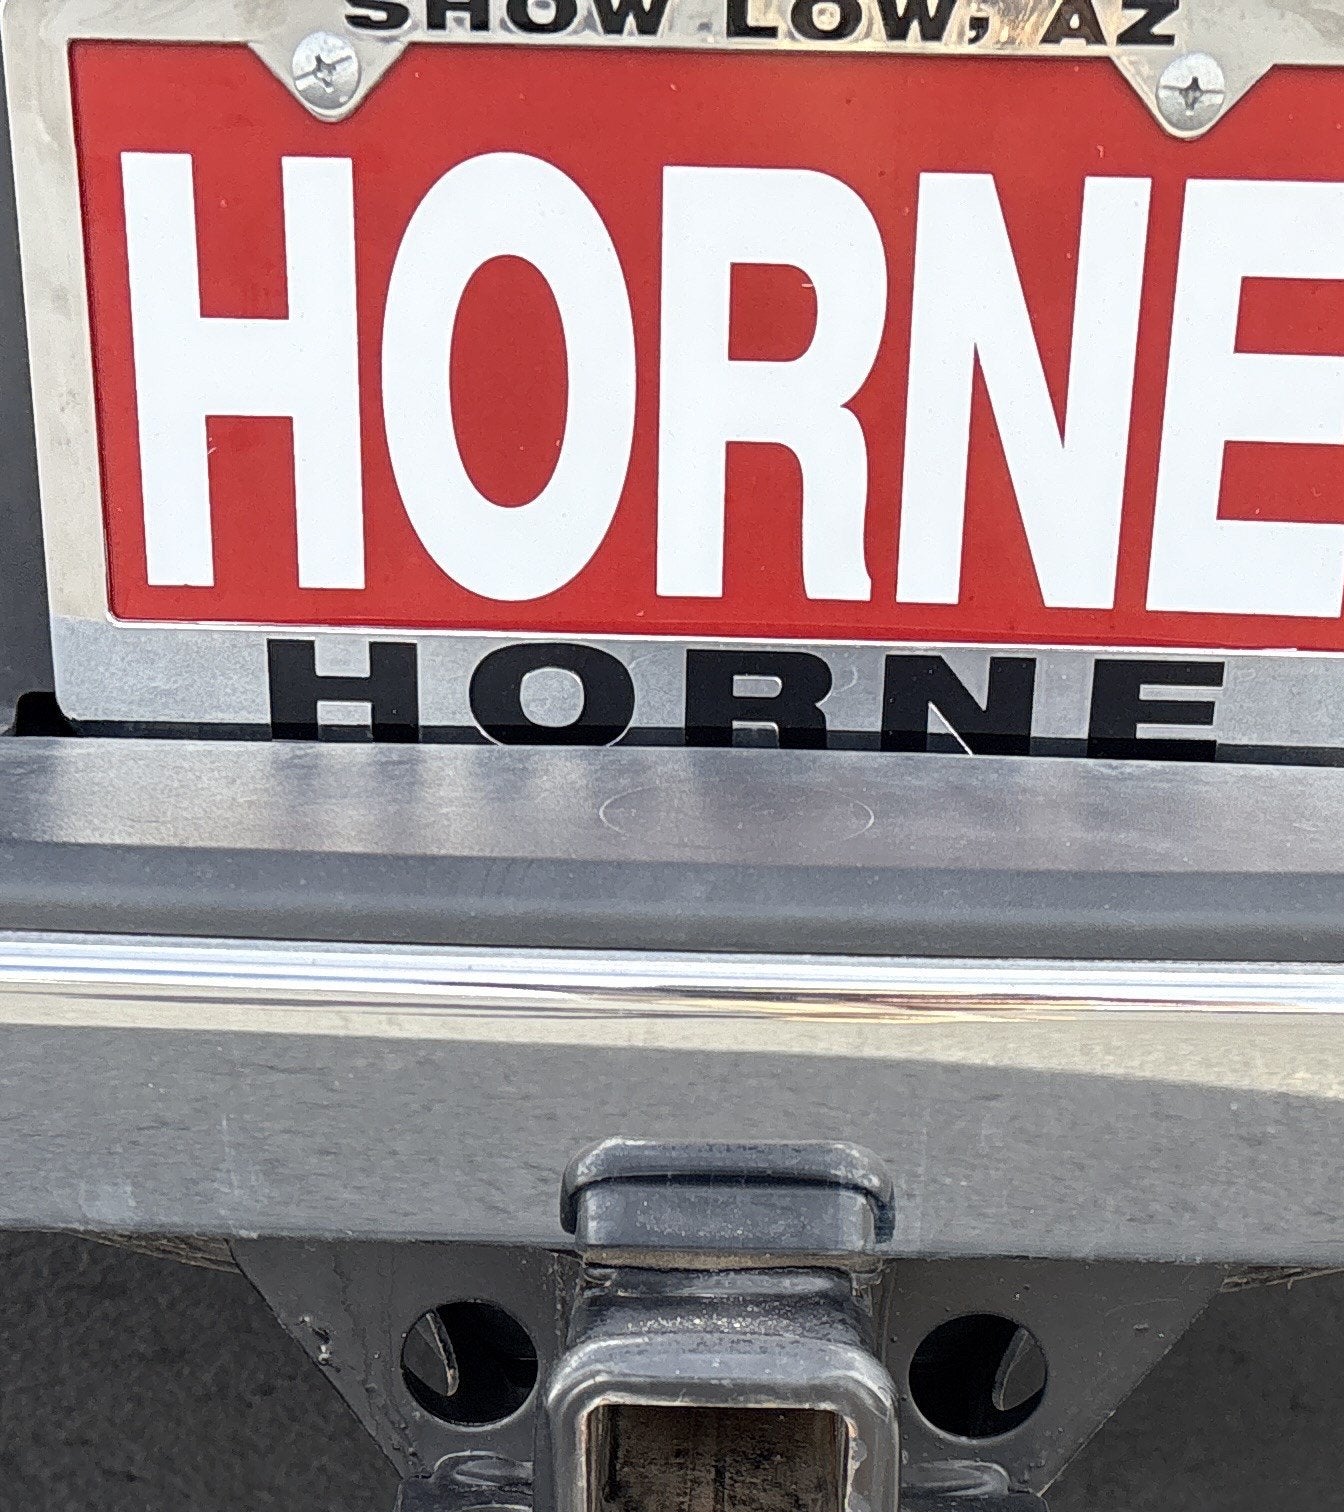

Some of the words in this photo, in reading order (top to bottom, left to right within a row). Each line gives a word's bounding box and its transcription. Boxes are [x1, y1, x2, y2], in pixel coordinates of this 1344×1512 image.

[346, 0, 668, 35] SHOW
[1039, 0, 1180, 46] AZ
[268, 640, 1226, 761] HORNE
